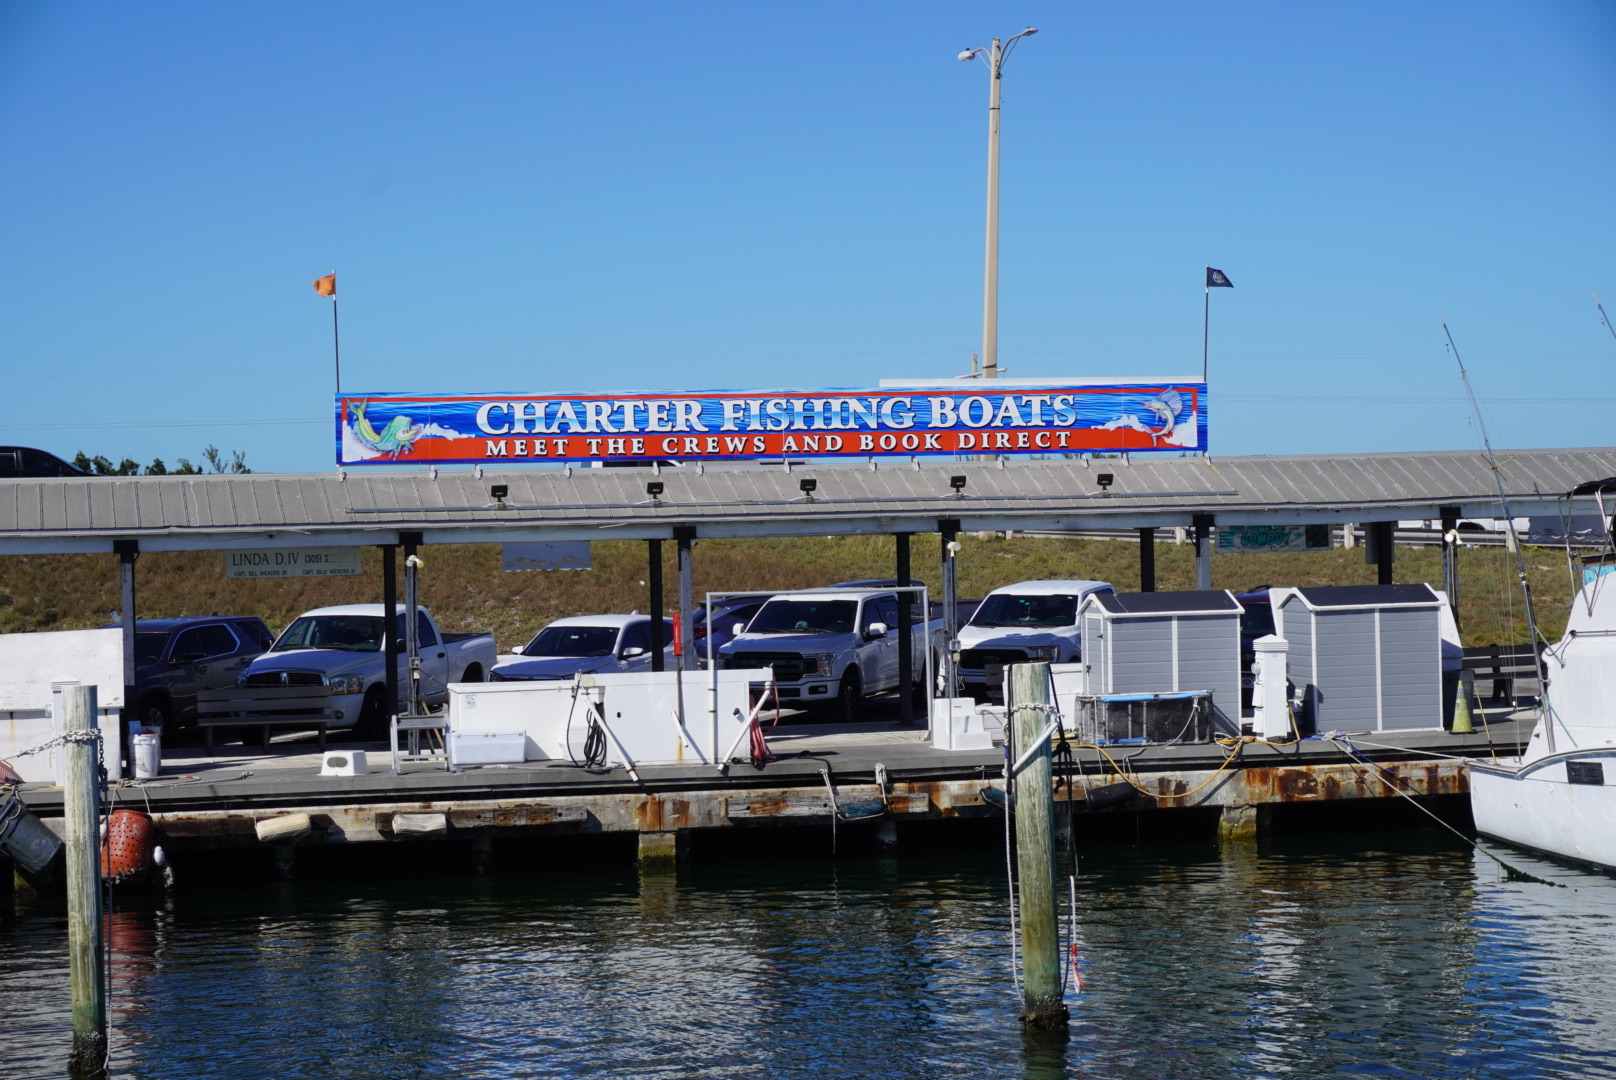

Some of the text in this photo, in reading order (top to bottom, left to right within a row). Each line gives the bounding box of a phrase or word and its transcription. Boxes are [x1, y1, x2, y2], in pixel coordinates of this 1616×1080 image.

[475, 394, 1077, 434] CHARTER FISHING BOATS
[485, 431, 1072, 457] MEET THE CREWS AND BOOK DIRECT
[1240, 532, 1292, 546] COWBOY
[232, 553, 270, 566] LINDA
[304, 554, 322, 564] (305)
